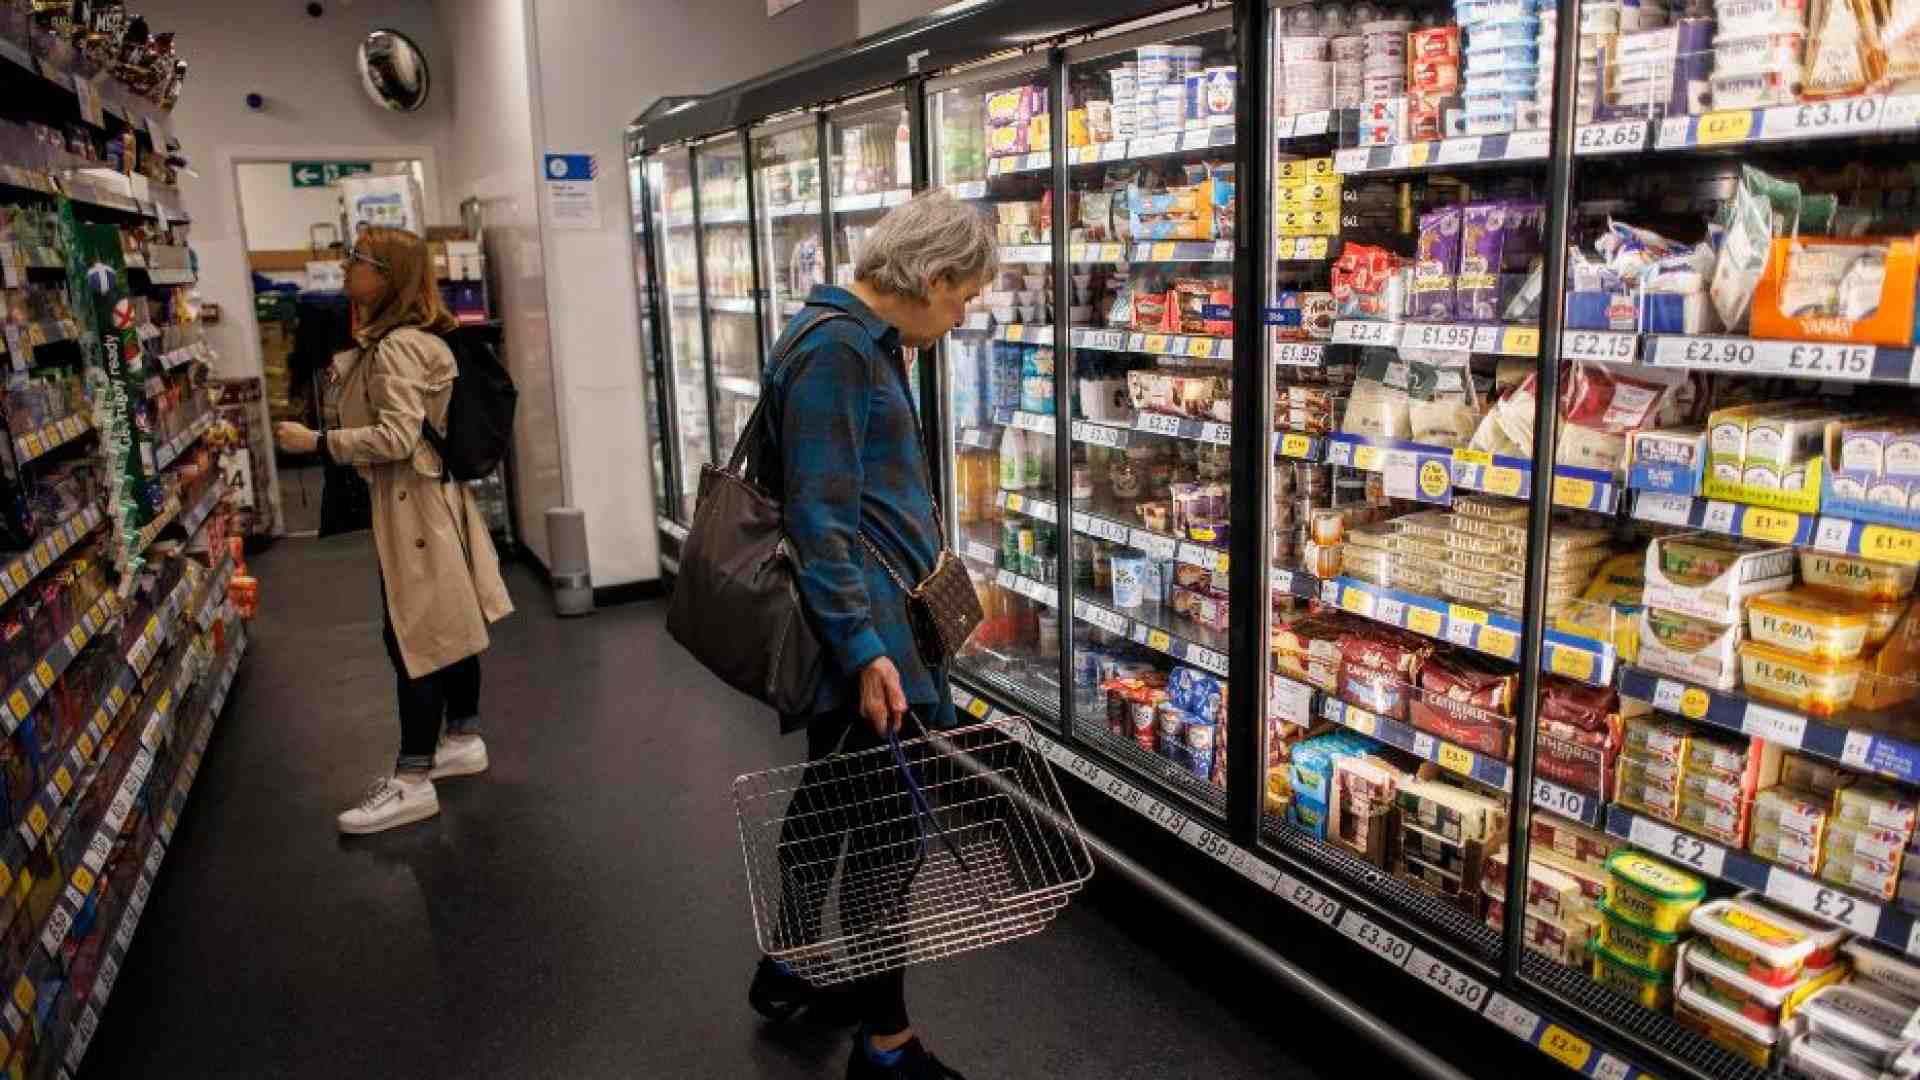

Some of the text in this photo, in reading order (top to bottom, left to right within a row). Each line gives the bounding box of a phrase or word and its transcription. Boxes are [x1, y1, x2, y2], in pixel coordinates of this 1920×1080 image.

[1795, 100, 1876, 129] £3.10
[1580, 124, 1642, 147] £2.65
[1421, 327, 1472, 346] £1.95
[1573, 335, 1632, 358] £2.15
[104, 334, 121, 375] ready
[1281, 345, 1318, 361] £1.95
[1685, 342, 1754, 364] £2.90
[1788, 348, 1867, 373] £2.15
[1816, 559, 1873, 578] FLORA
[1762, 618, 1815, 641] FLORA
[1754, 662, 1809, 688] FLORA
[1150, 801, 1181, 833] £1.75
[1197, 831, 1227, 857] 95p
[1672, 836, 1706, 867] £2
[1292, 880, 1336, 919] £2.70
[1814, 890, 1855, 920] £2
[1356, 924, 1405, 961] £3.30
[1427, 963, 1481, 1003] £3.30
